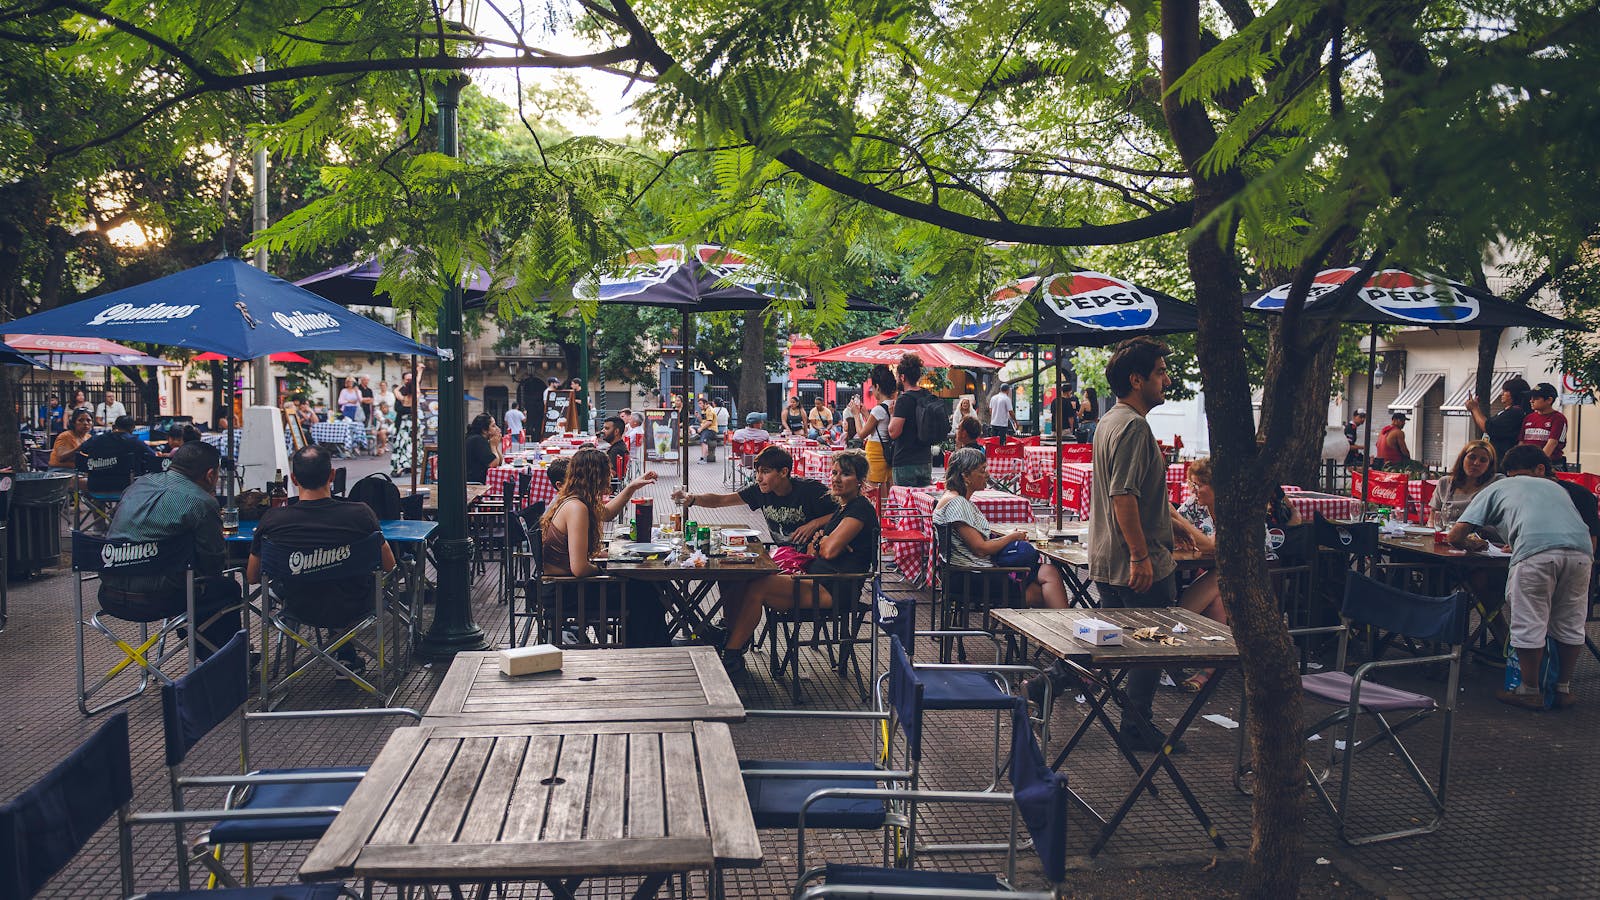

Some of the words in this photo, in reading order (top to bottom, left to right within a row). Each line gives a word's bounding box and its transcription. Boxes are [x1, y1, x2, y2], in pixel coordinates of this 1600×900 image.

[1056, 291, 1144, 311] PEPSI
[86, 302, 200, 325] Quilmes
[272, 310, 340, 337] Quilmes
[87, 457, 119, 471] Quilmes
[1371, 485, 1397, 500] Coca-Cola
[101, 542, 158, 568] Quilmes
[289, 544, 351, 575] Quilmes
